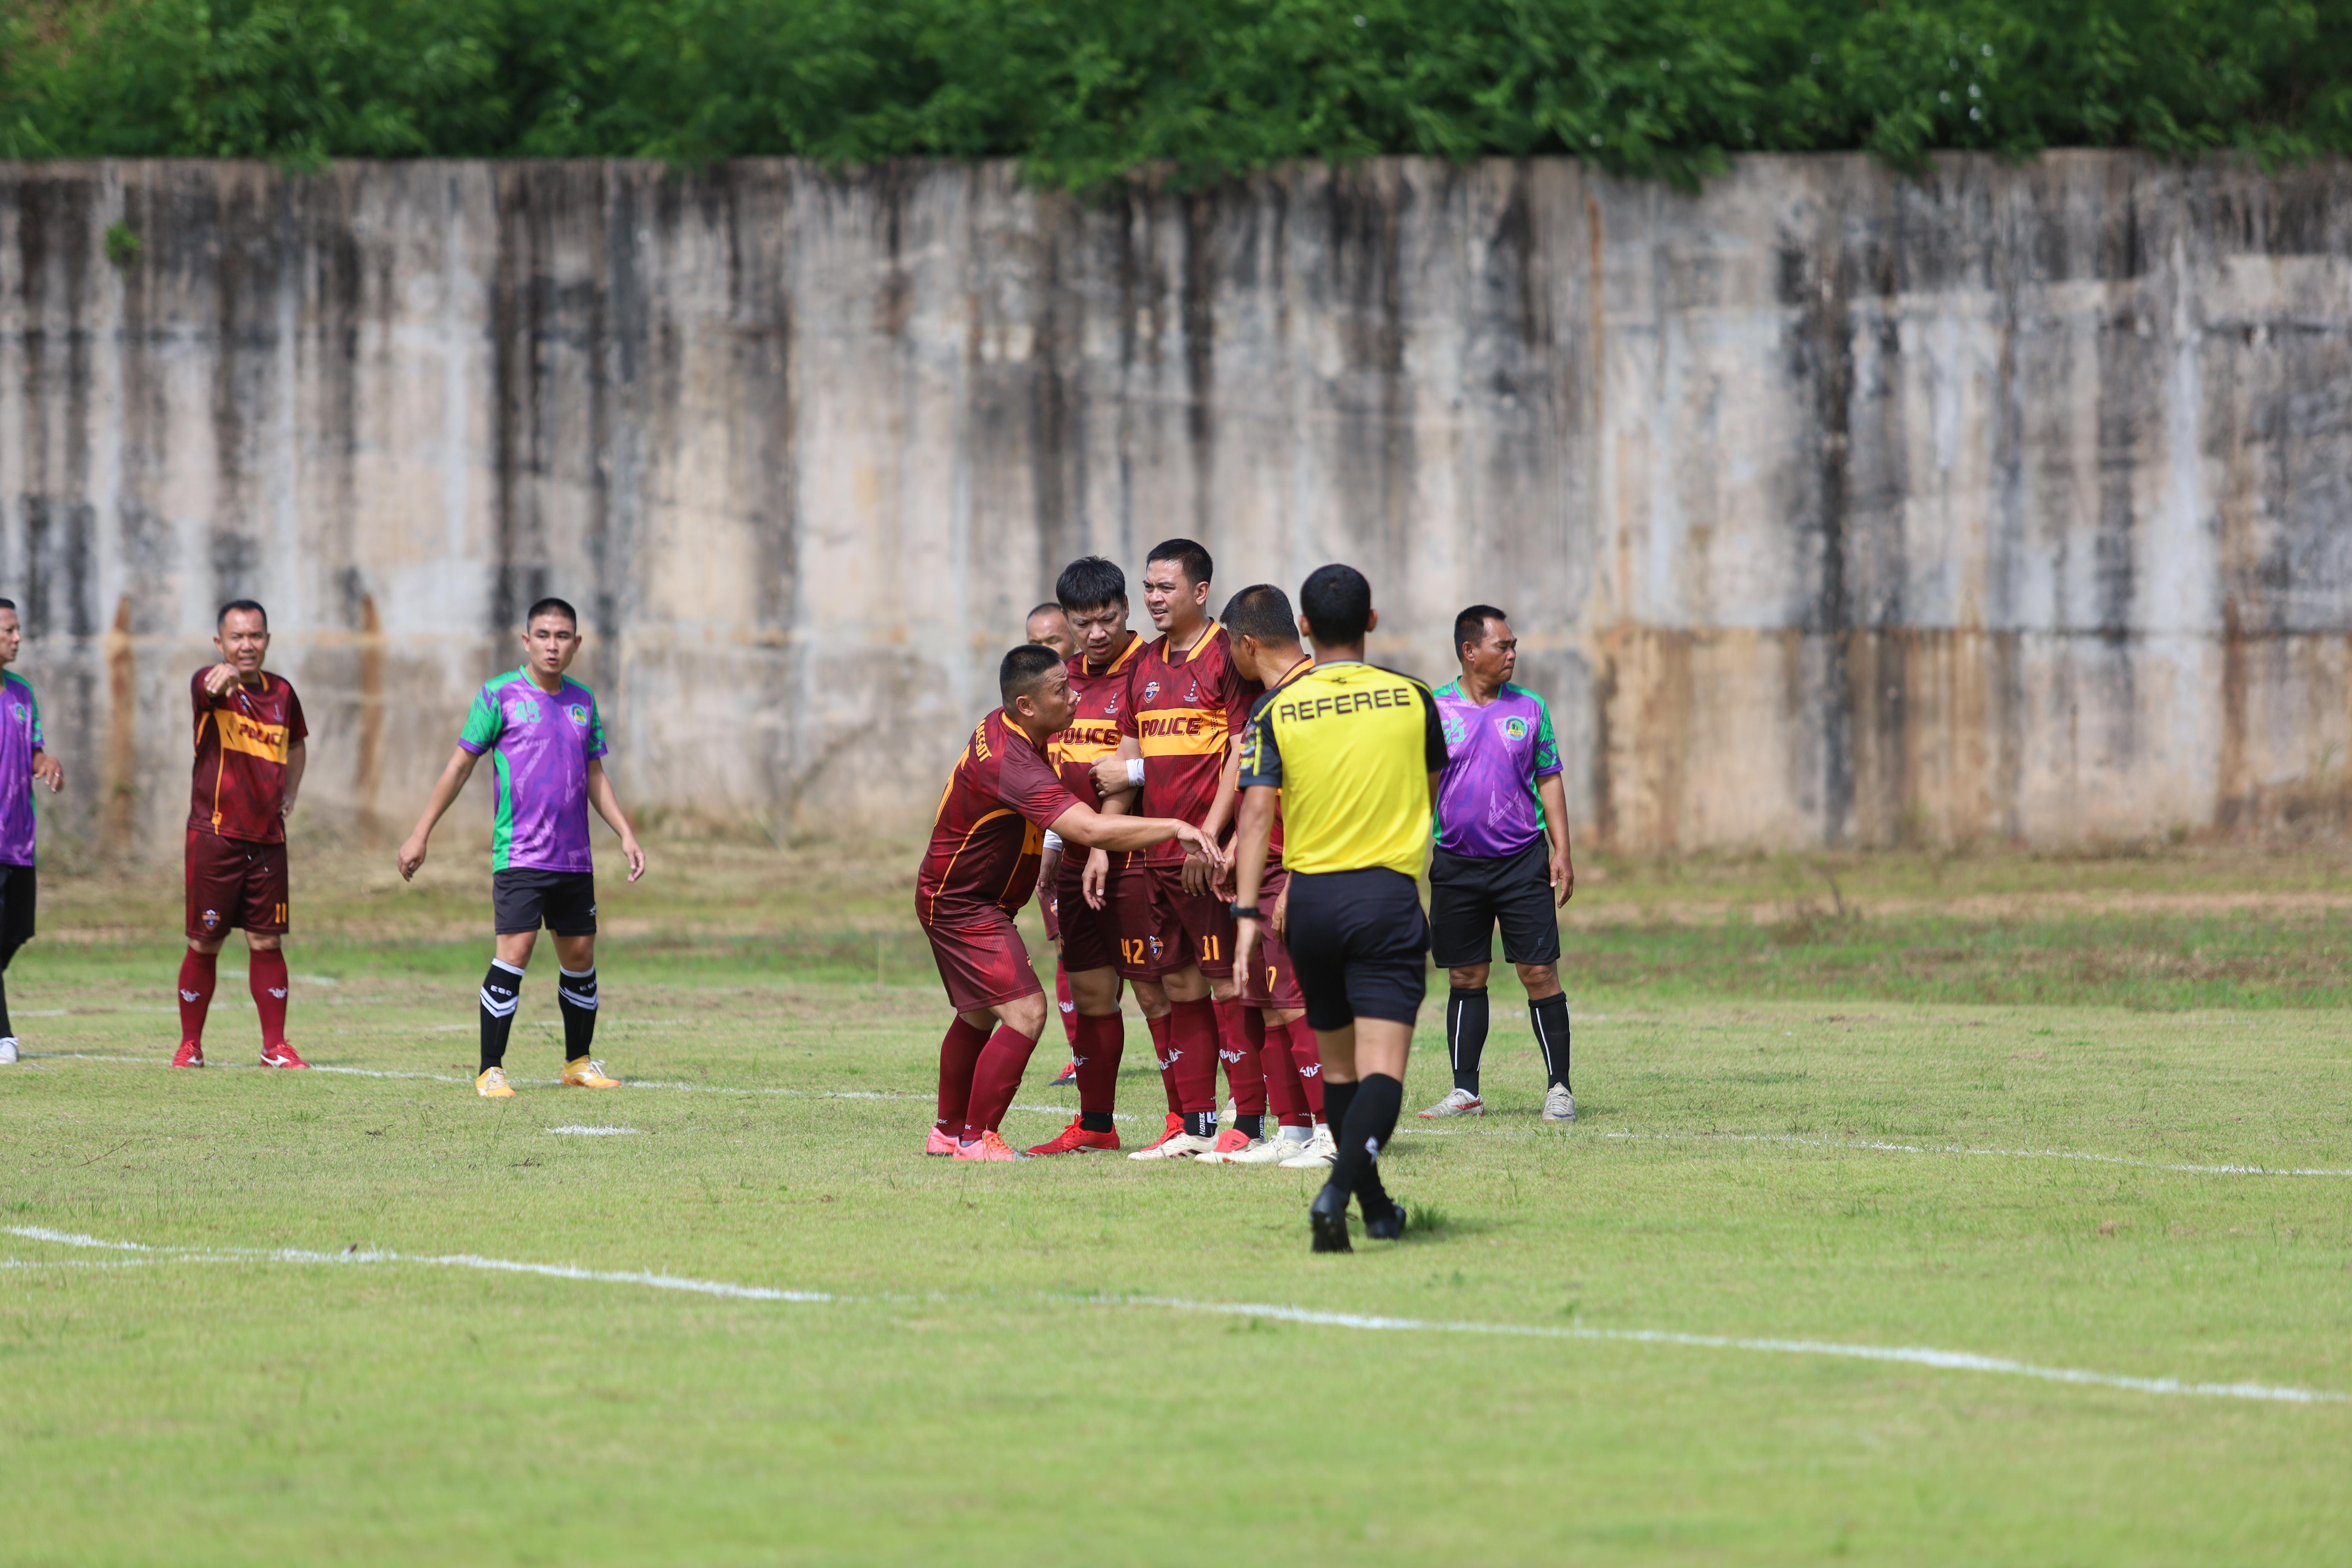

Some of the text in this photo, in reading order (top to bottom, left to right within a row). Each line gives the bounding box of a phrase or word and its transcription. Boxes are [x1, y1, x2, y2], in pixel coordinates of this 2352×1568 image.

[515, 701, 540, 723] 49
[1280, 688, 1410, 723] REFEREE
[1141, 717, 1203, 739] POLICE
[1120, 938, 1145, 965] 42
